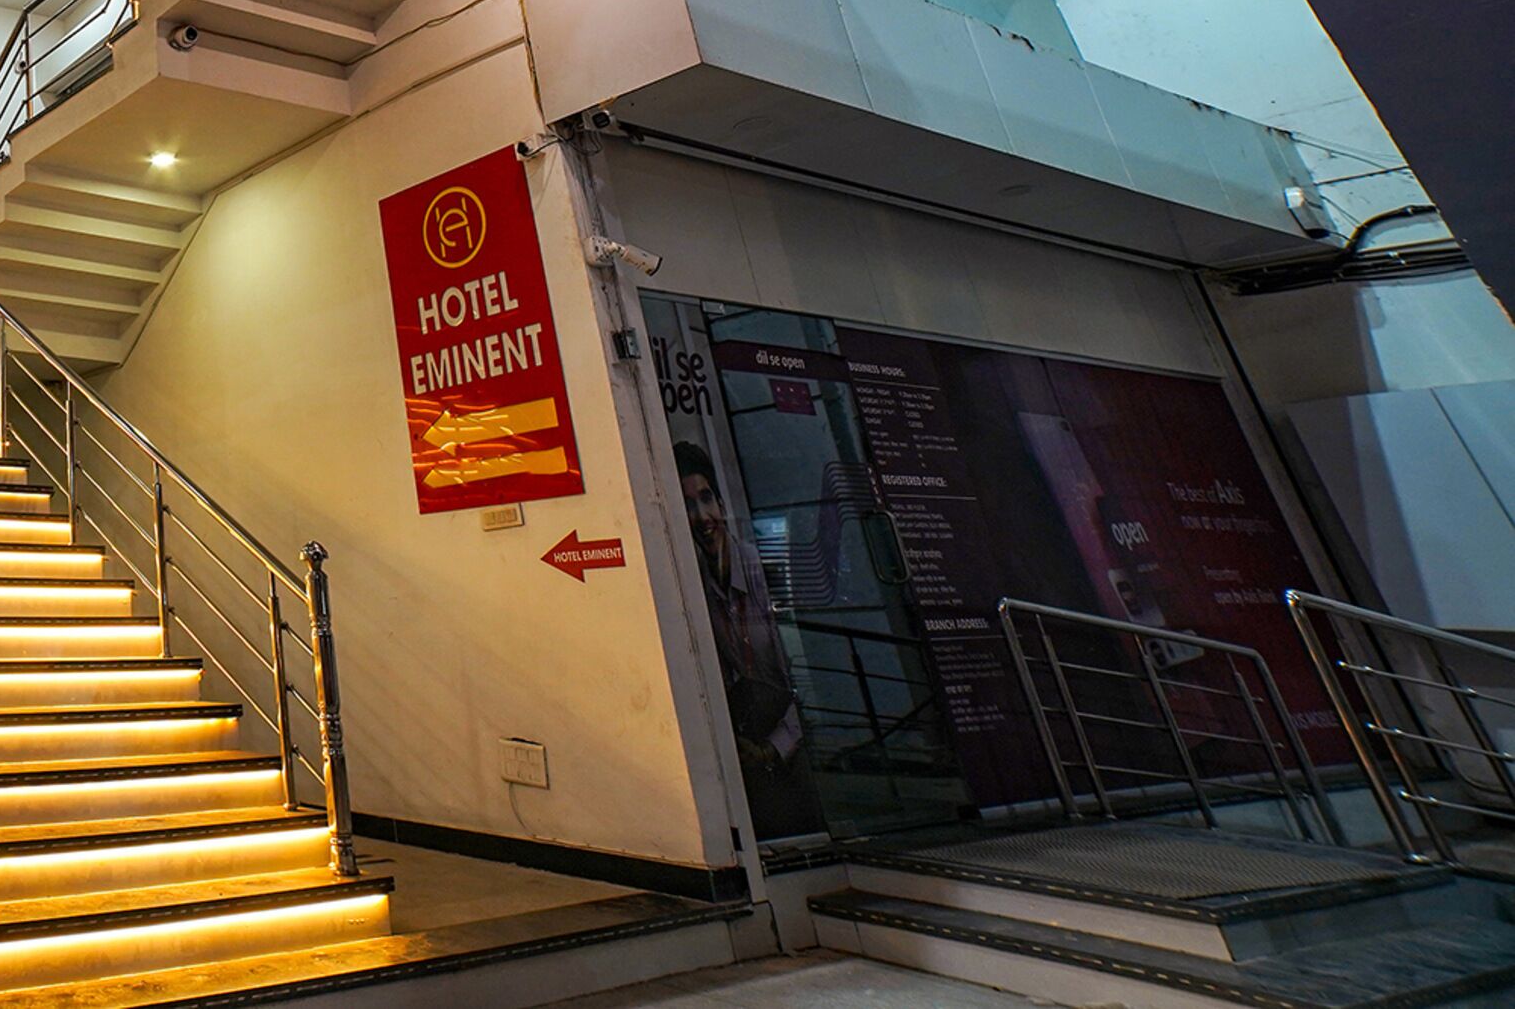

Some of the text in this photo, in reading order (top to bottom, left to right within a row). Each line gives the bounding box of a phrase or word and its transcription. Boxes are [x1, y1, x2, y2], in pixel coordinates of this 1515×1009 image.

[417, 271, 519, 335] HOTEL
[410, 323, 543, 395] EMINENT
[649, 337, 707, 383] il se
[769, 355, 781, 366] se
[781, 357, 805, 370] open
[659, 381, 714, 422] pen
[553, 547, 622, 563] HOTEL EMINENT
[1111, 521, 1149, 551] open
